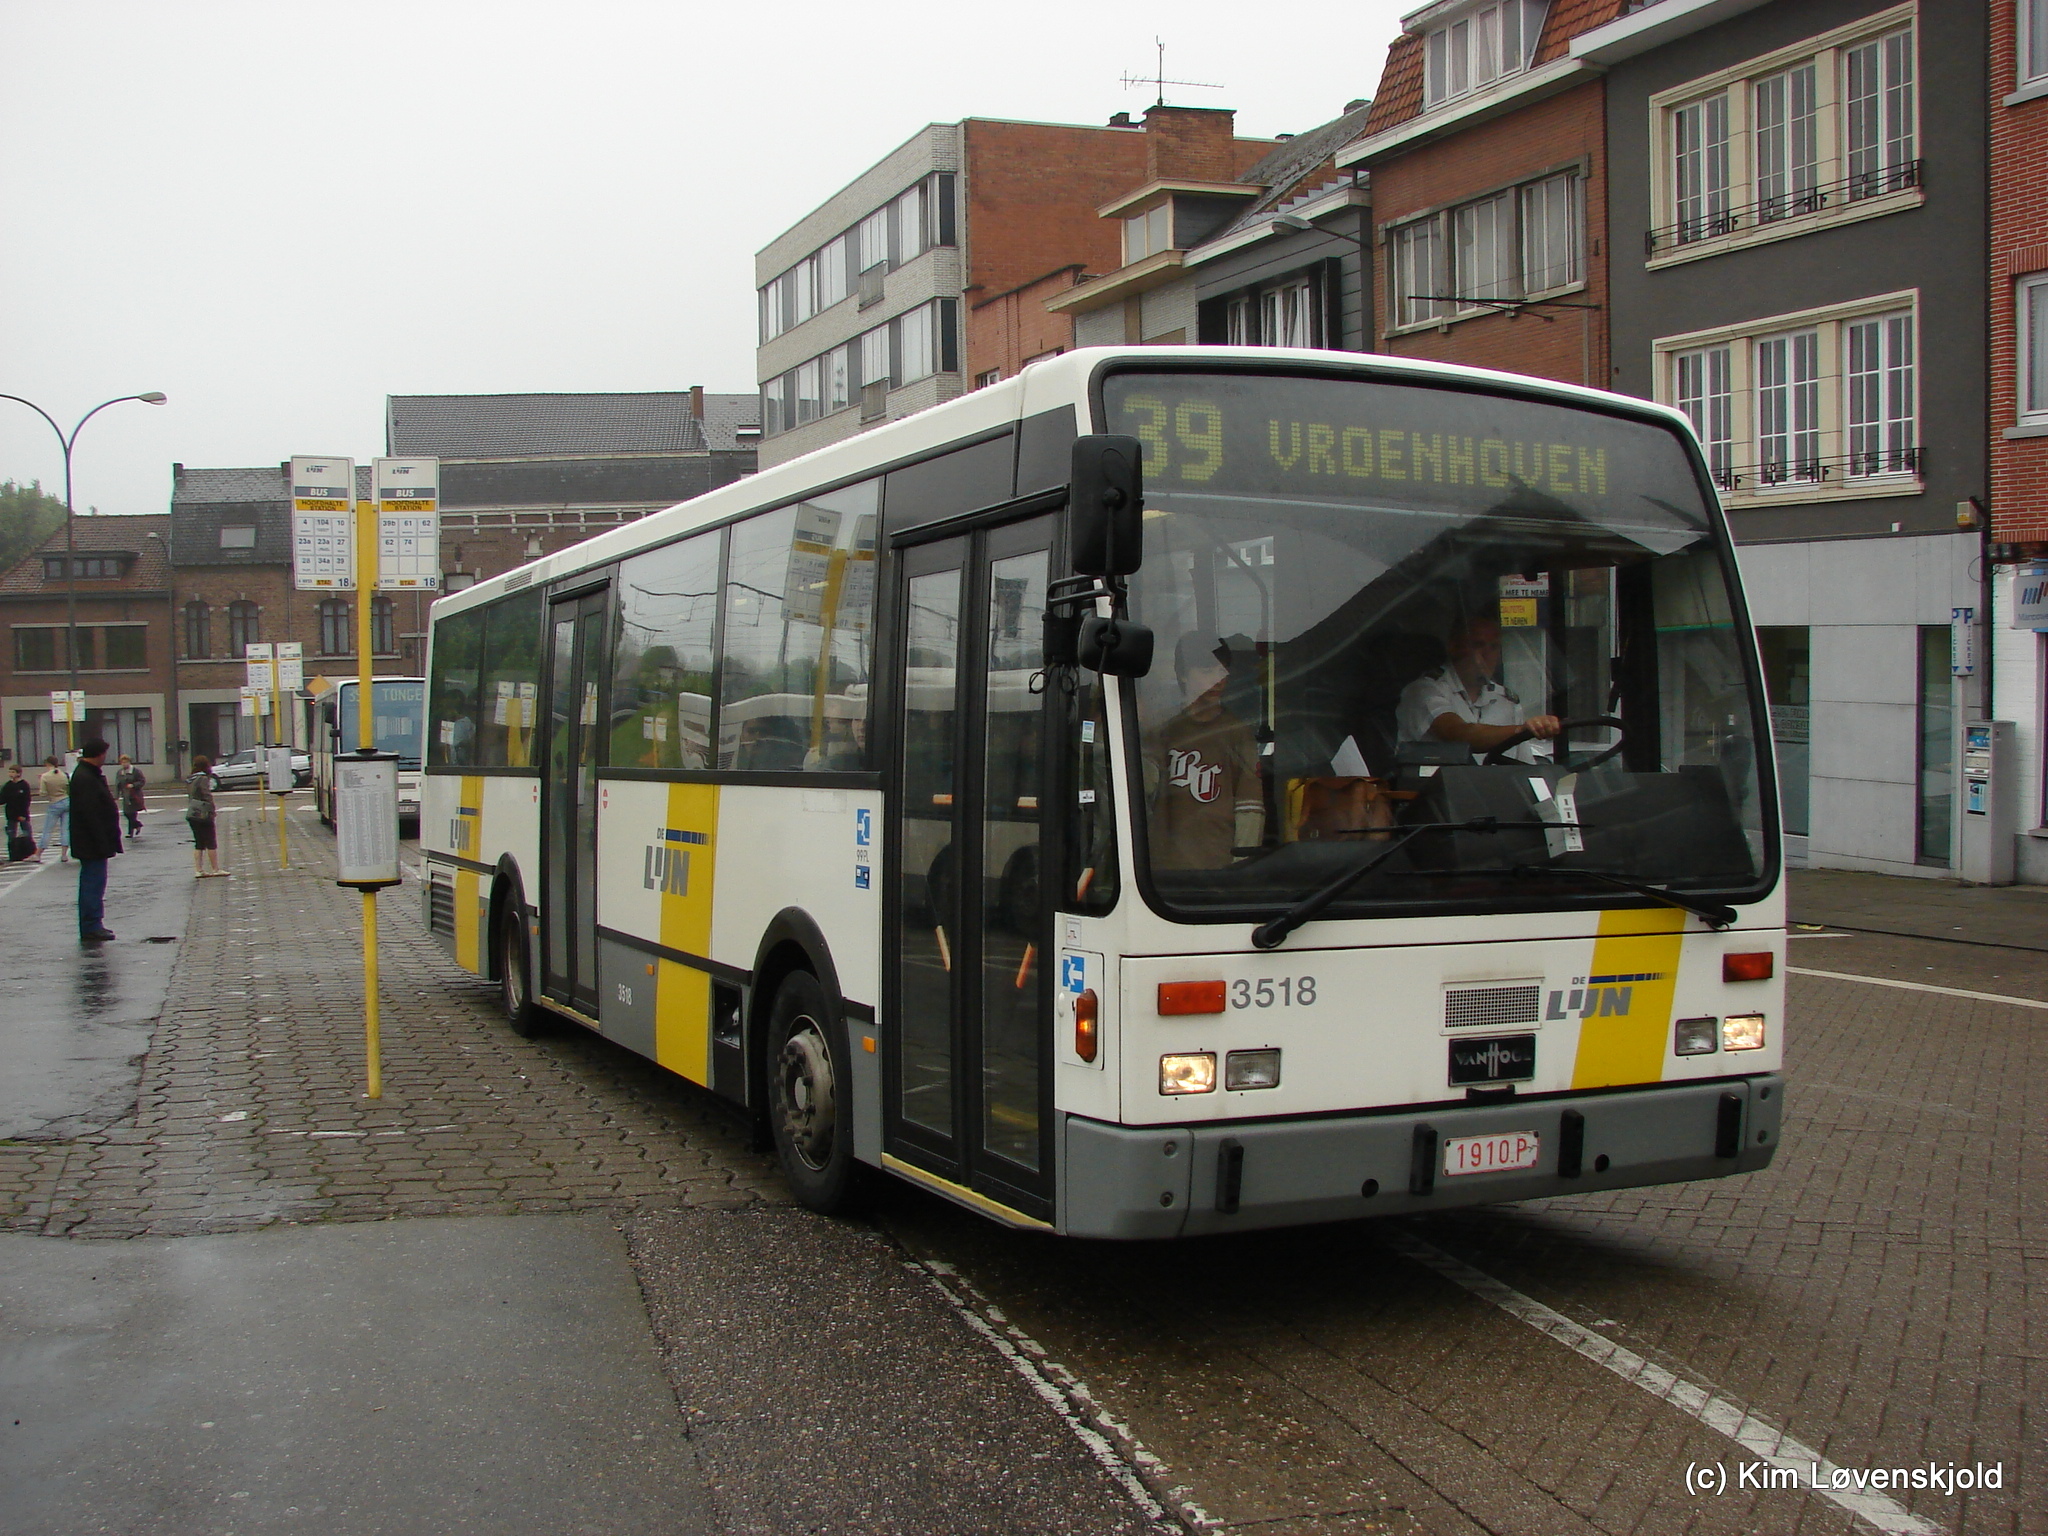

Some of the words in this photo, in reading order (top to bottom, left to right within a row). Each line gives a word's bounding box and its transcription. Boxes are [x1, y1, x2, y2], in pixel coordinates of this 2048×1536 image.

[1122, 394, 1224, 481] 39
[1269, 418, 1607, 495] VROENHOVEN
[310, 488, 329, 497] BUS
[396, 489, 415, 498] BUS
[338, 578, 350, 587] 18
[424, 577, 436, 587] 18
[1964, 609, 1973, 624] P
[450, 818, 471, 852] LIJN
[657, 827, 665, 839] DE
[644, 845, 690, 897] LIJN
[1571, 976, 1586, 985] DE
[617, 983, 632, 1006] 3518
[1231, 976, 1317, 1010] 3518
[1545, 987, 1633, 1021] LIJN
